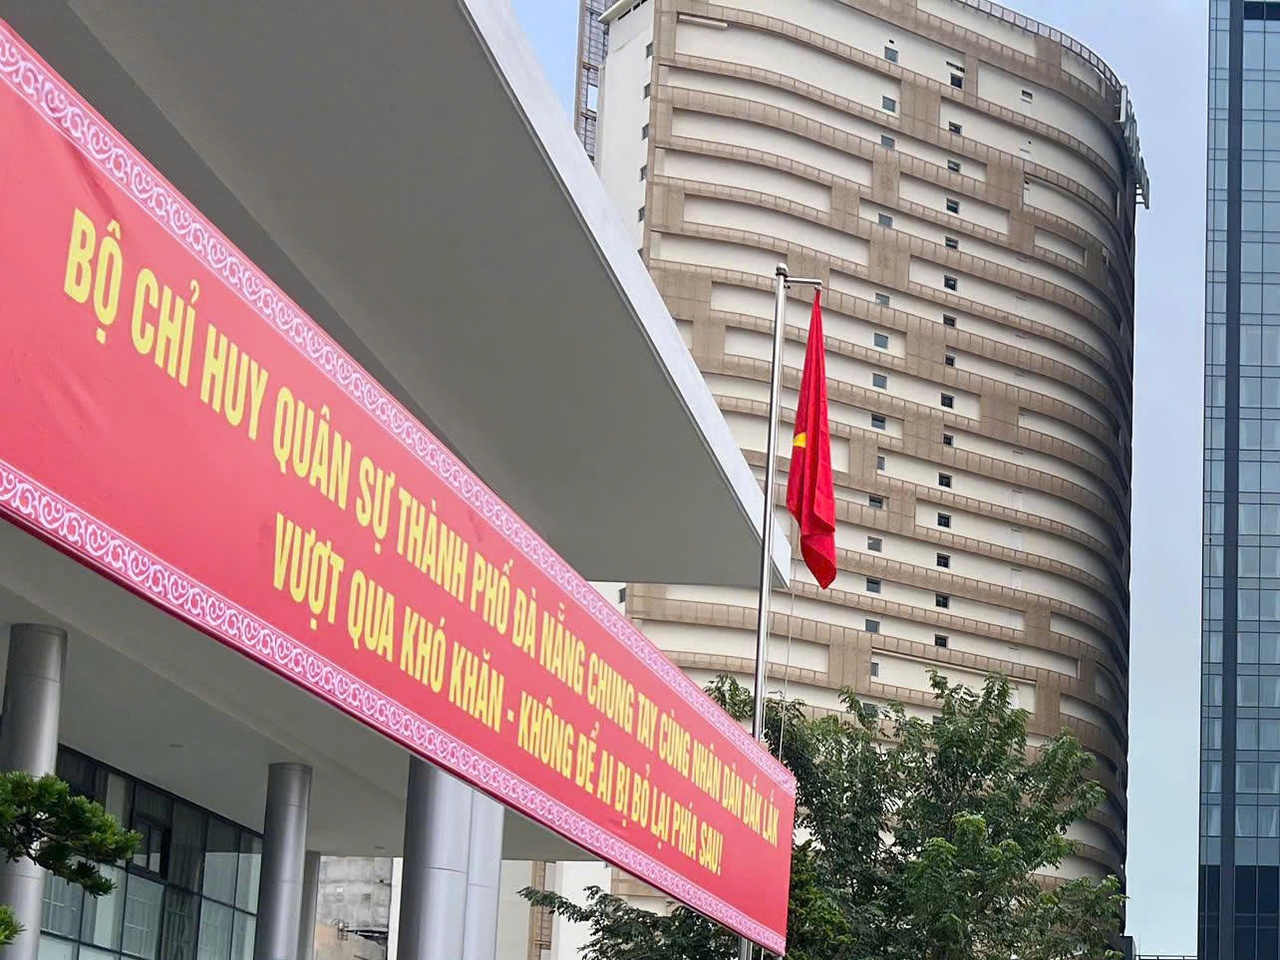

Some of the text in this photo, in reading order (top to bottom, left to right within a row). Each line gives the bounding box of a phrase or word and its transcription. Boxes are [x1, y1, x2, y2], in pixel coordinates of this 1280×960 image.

[64, 207, 780, 848] BỘ CHỈ HUY QUÂN SỰ THÀNH PHỐ ĐÀ NẴNG CHUNG TAY CÙNG NHÂN DÂN ĐẮK LẮK
[273, 512, 724, 877] VƯỢT QUA KHÓ KHĂN - KHÔNG ĐỂ AI BỊ BỎ LẠI PHÍA SAU!
